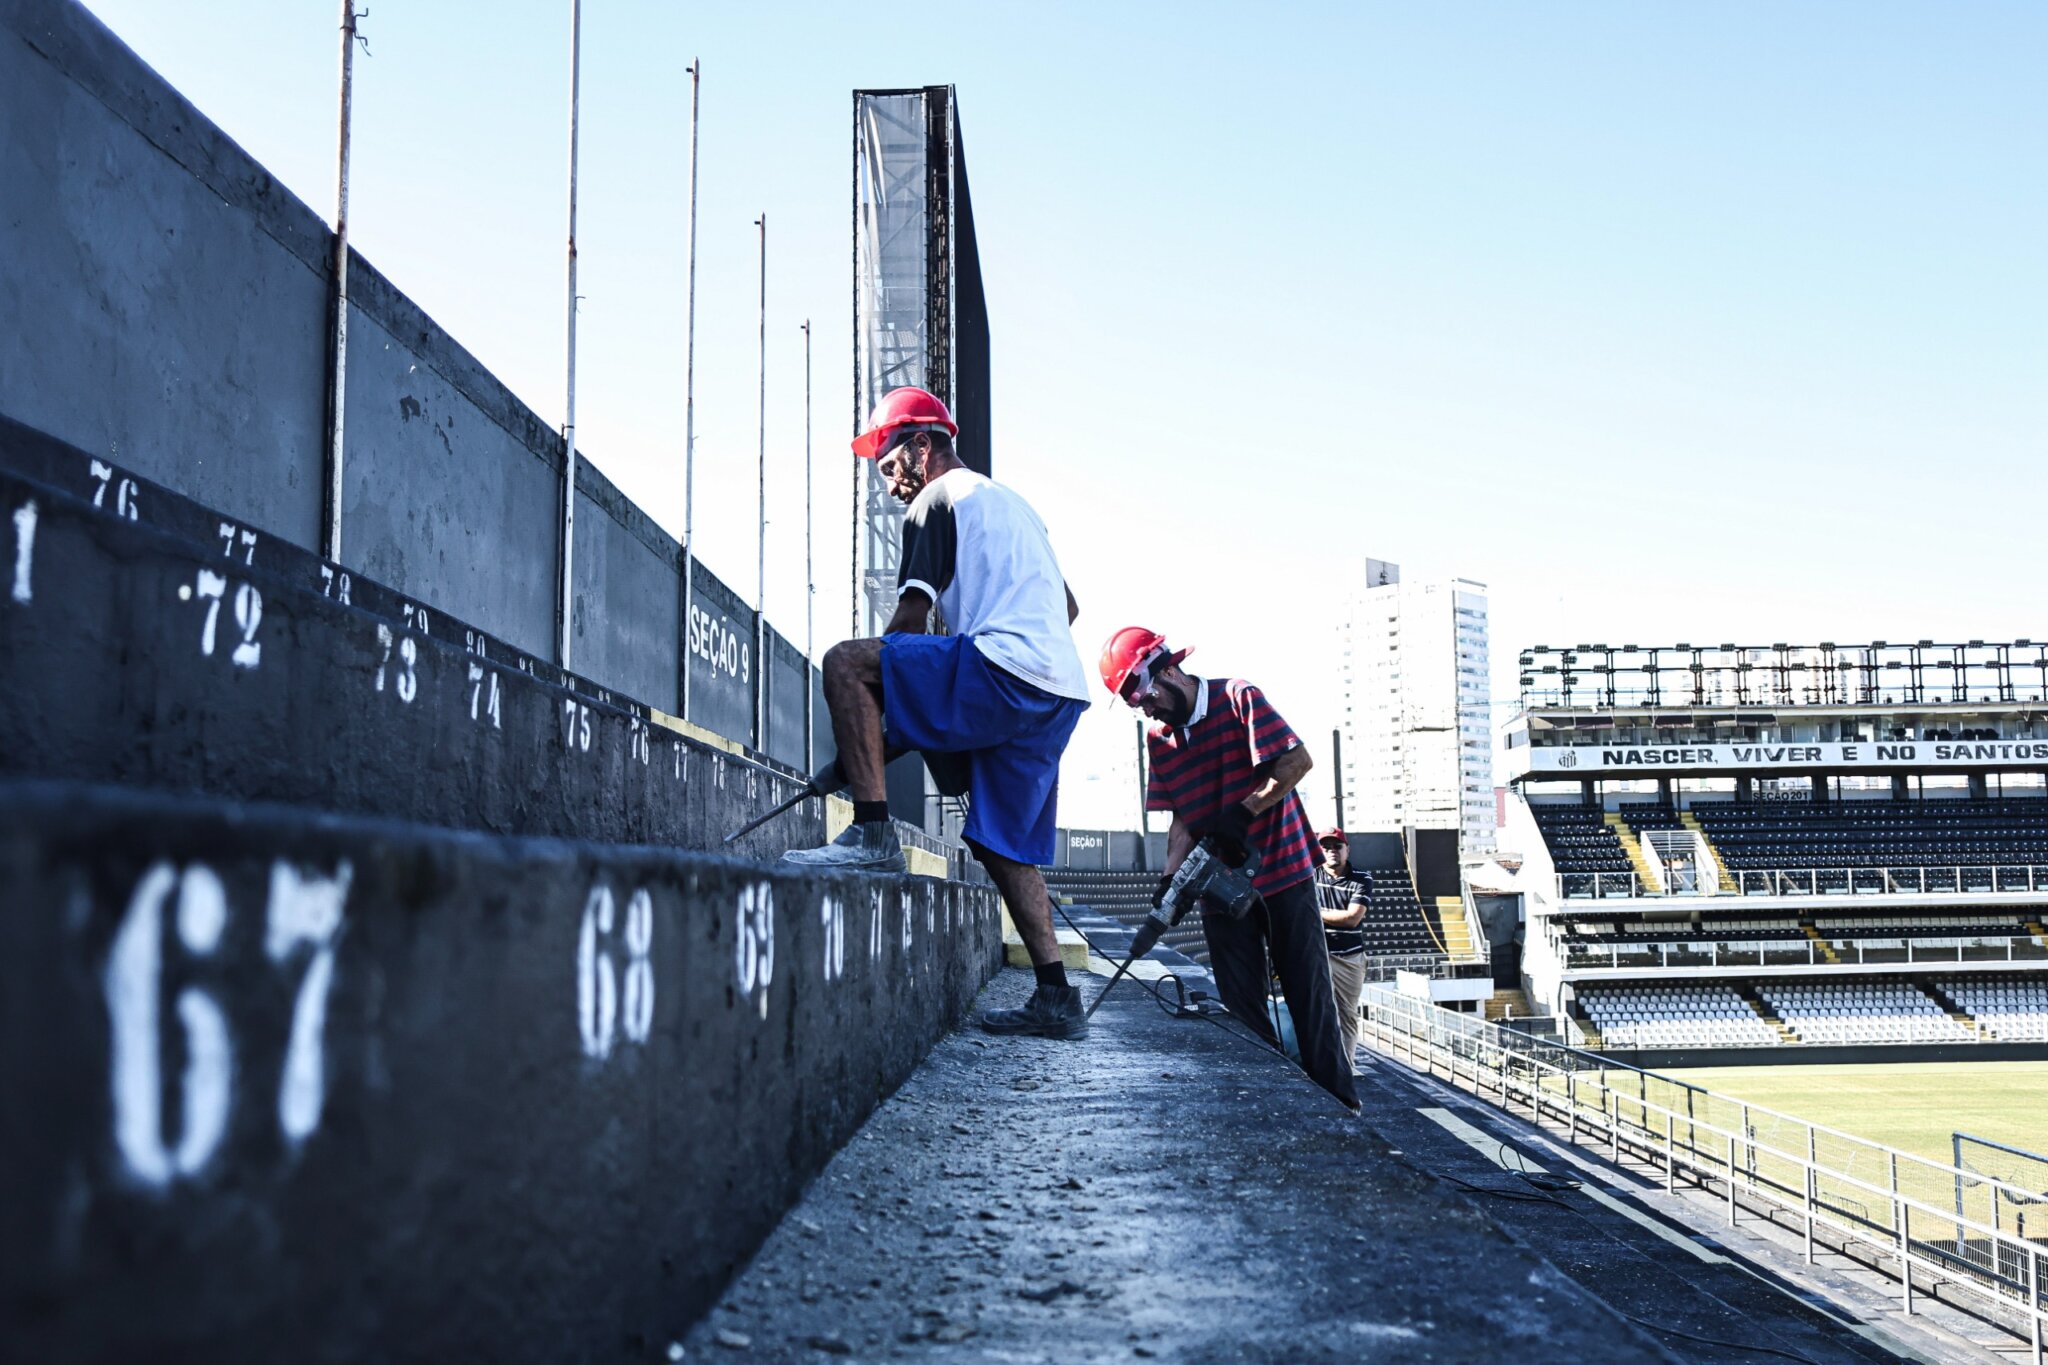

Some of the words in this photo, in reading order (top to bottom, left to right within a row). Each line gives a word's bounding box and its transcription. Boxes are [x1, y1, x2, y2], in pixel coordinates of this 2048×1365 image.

[90, 460, 138, 522] 76
[219, 522, 257, 566] 77
[197, 569, 263, 669] 72
[375, 622, 417, 704] 73
[565, 698, 591, 753] 75
[690, 604, 738, 679] SEÇÃO
[741, 642, 749, 684] 9
[1603, 748, 1719, 765] NASCER,
[1732, 746, 1822, 763] VIVER
[1842, 745, 1858, 761] E
[1876, 745, 1916, 761] NO
[1935, 743, 2048, 760] SANTOS
[1790, 790, 1808, 800] 201
[1071, 835, 1096, 850] SEÇÃO
[1096, 837, 1103, 848] 11
[104, 860, 353, 1186] 67
[577, 883, 655, 1062] 68
[736, 879, 775, 998] 69
